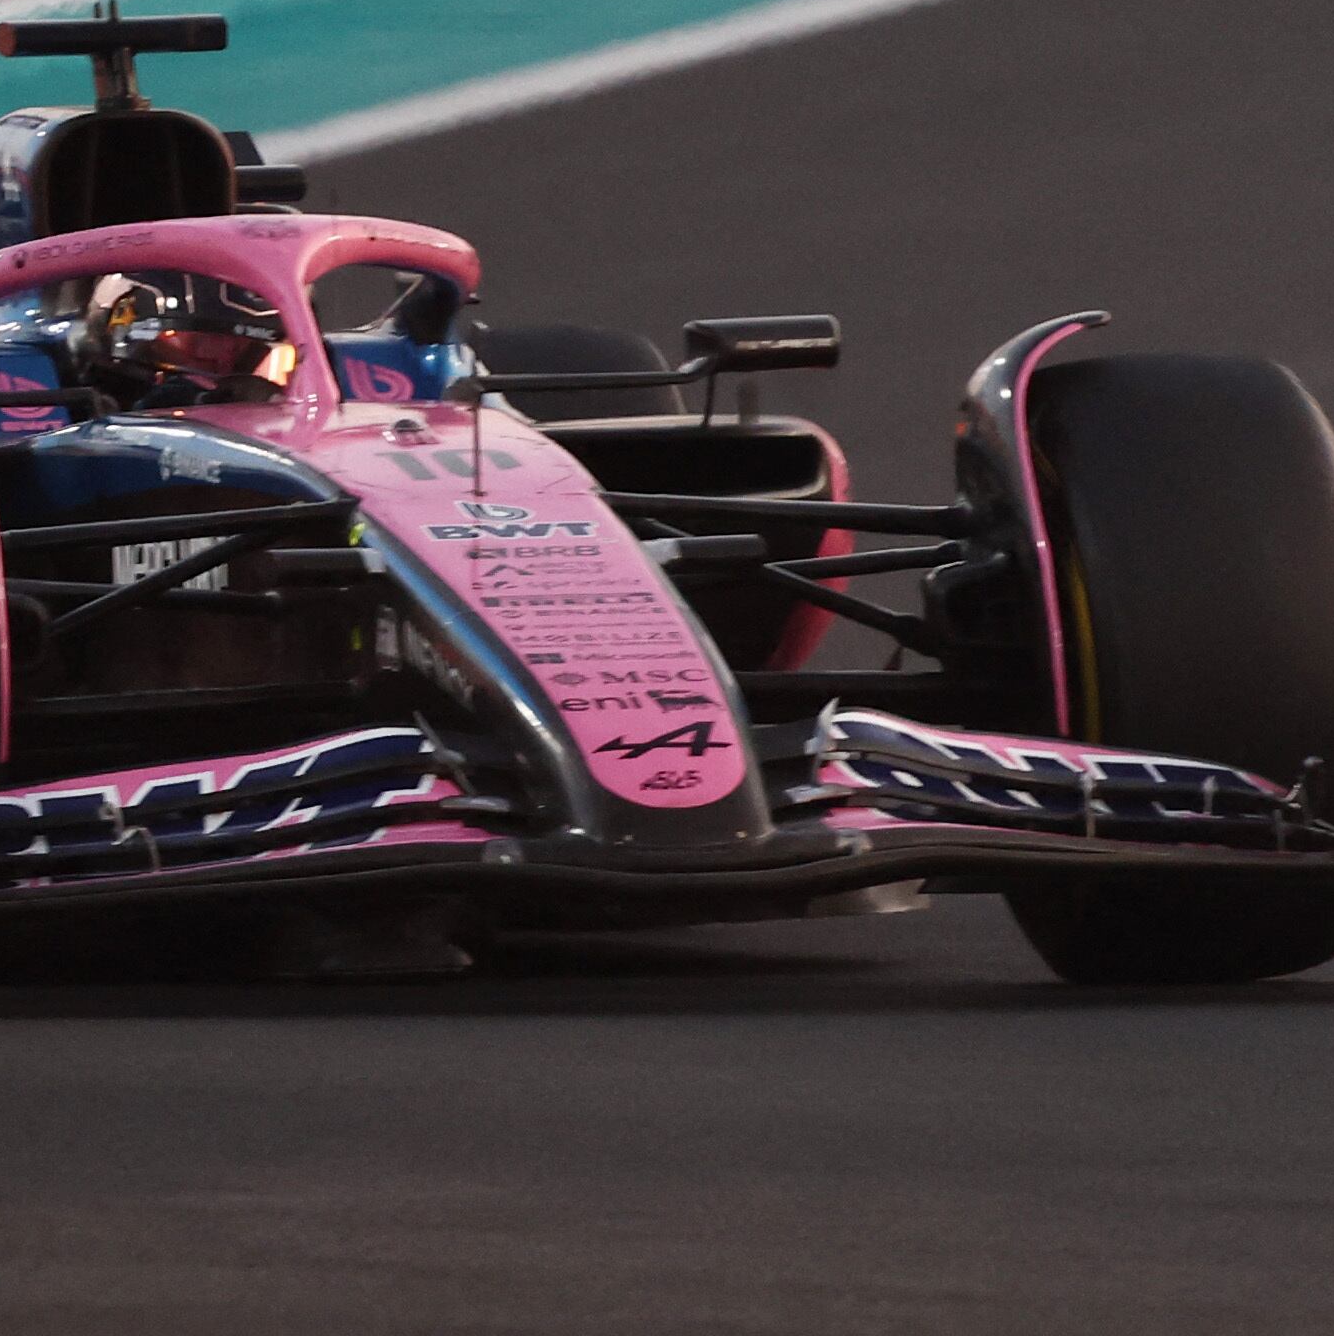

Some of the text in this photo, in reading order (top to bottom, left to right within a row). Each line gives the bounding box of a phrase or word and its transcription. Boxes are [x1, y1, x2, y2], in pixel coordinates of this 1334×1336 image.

[373, 448, 523, 481] 10
[424, 521, 598, 540] BWT
[514, 544, 602, 559] BRB
[597, 668, 710, 685] MSC
[561, 691, 643, 712] eni
